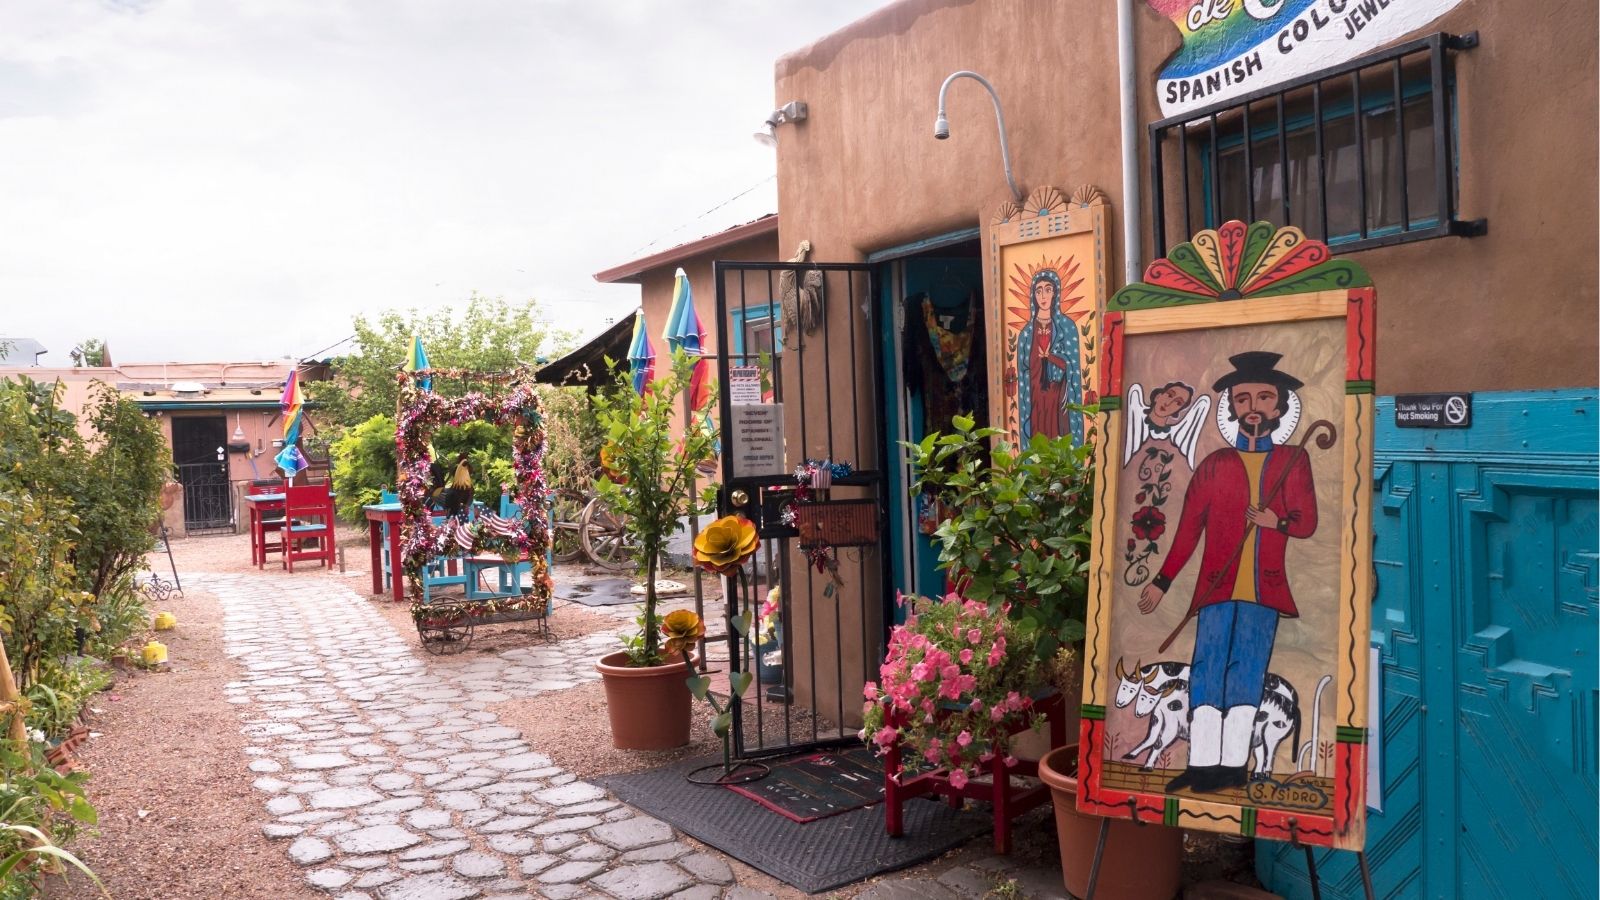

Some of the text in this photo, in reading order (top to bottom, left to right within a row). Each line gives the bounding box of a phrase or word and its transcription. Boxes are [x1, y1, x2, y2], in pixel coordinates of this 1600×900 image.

[1187, 0, 1234, 31] de
[1165, 52, 1263, 104] SPANISH
[1398, 403, 1443, 411] Thank You For
[1398, 412, 1438, 421] Not Smoking
